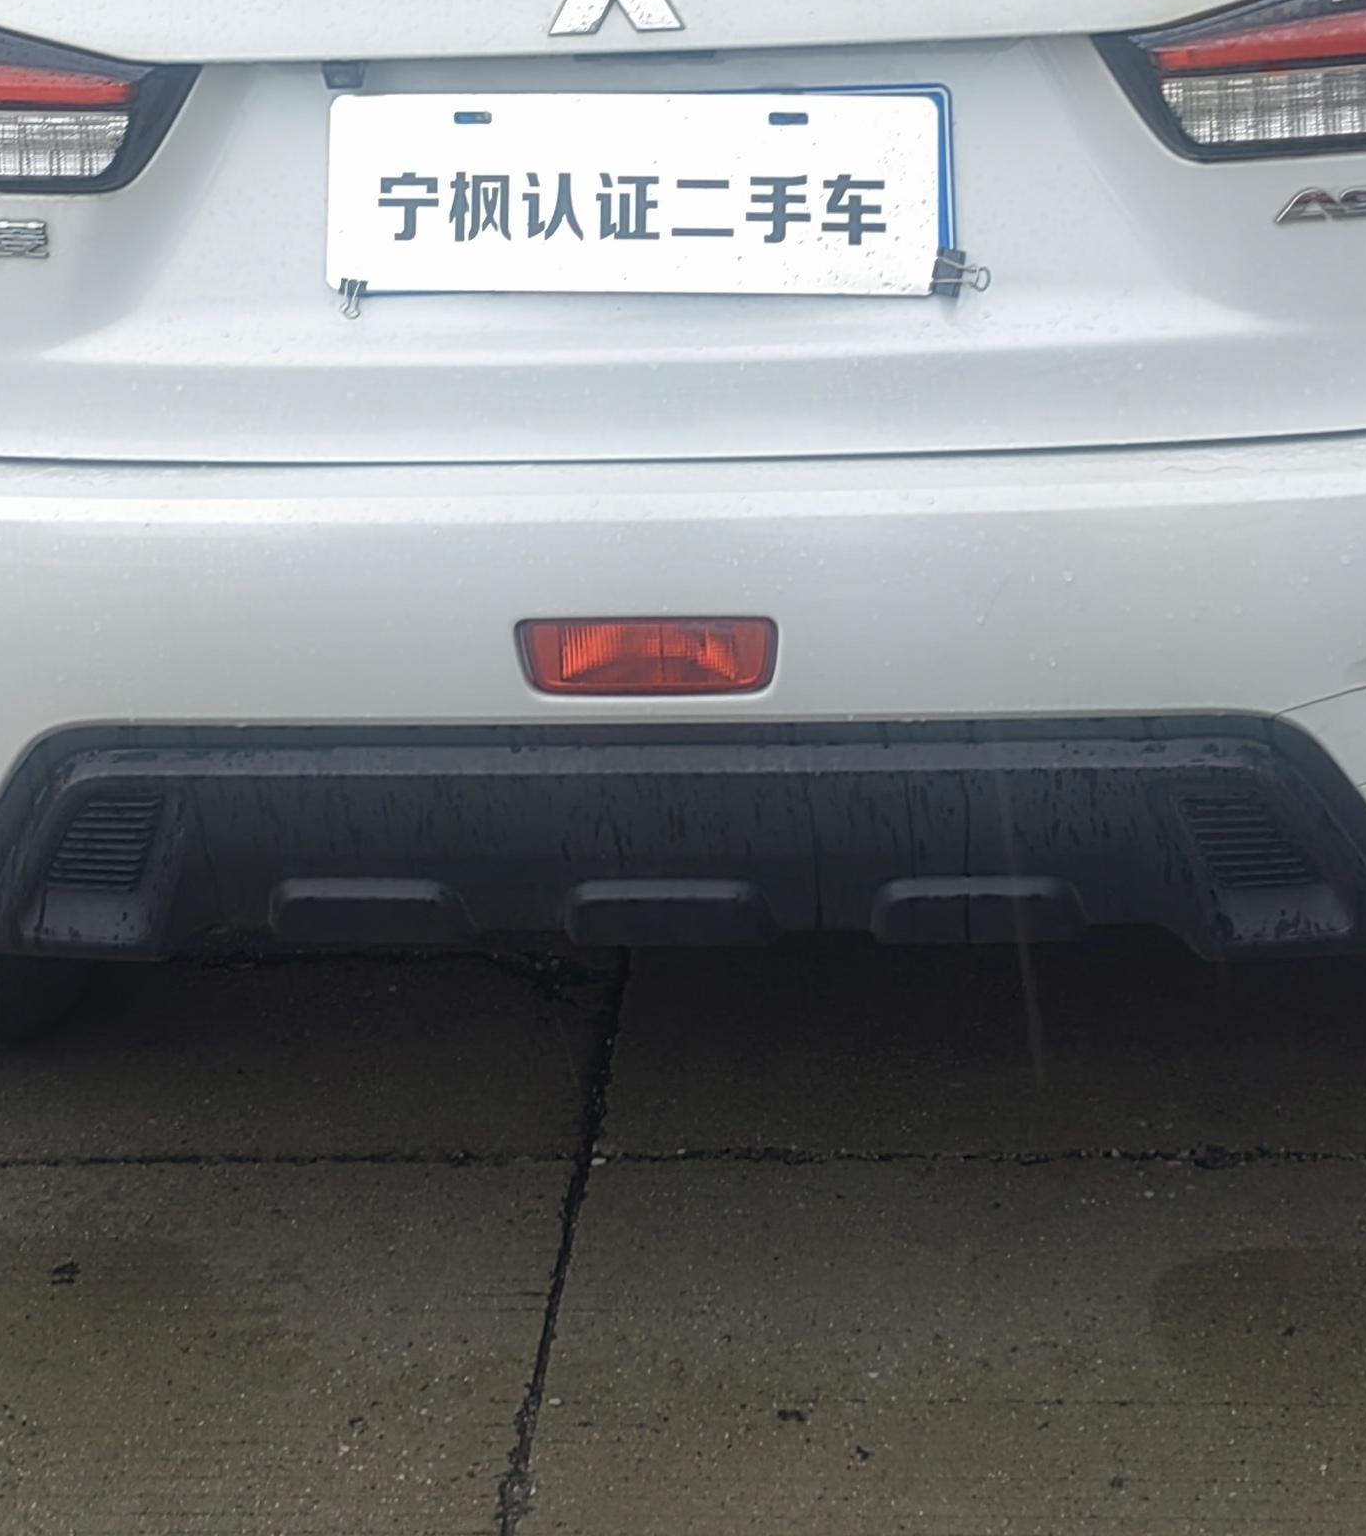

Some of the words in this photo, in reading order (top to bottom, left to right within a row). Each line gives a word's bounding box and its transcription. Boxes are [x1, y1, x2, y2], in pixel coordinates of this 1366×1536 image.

[378, 172, 888, 246] 宁枫认证二手车
